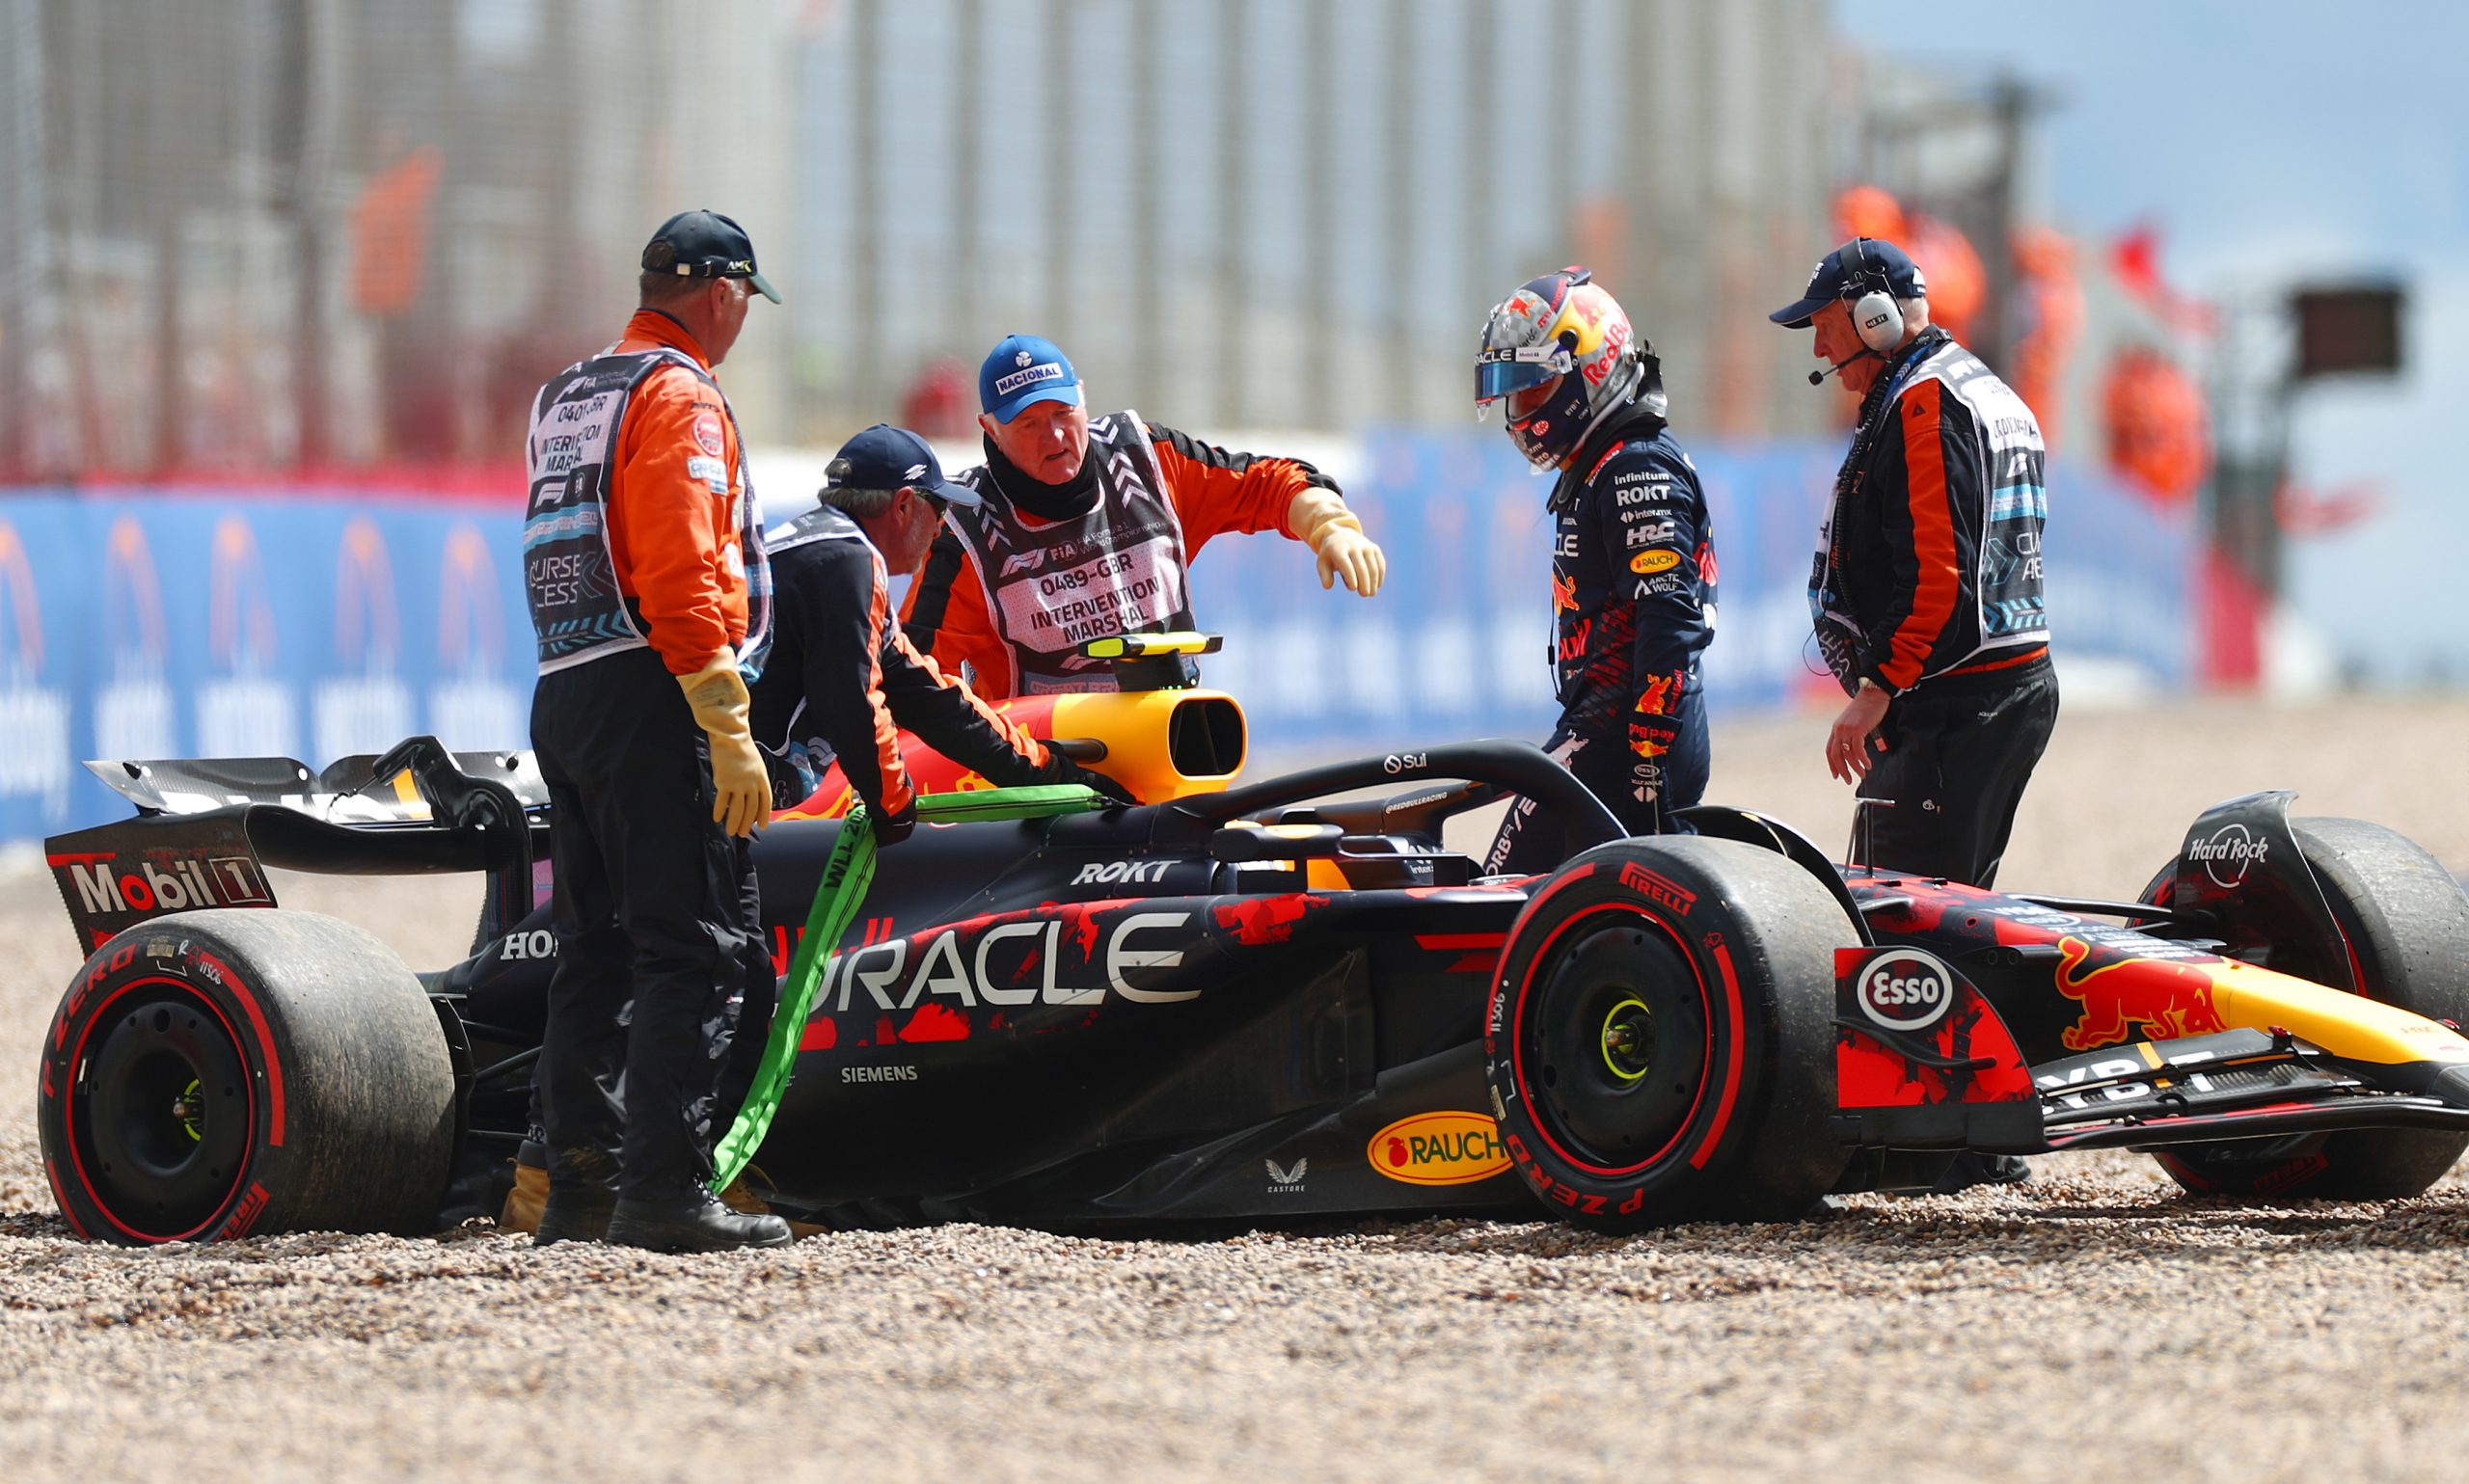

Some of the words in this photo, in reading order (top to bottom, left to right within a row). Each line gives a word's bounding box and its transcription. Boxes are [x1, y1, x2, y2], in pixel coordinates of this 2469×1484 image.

[1583, 335, 1618, 386] Red
[997, 366, 1058, 391] NACIONAL
[1614, 472, 1669, 485] infinitum
[1615, 485, 1670, 507] ROKT
[1626, 522, 1675, 546] HRC
[1642, 555, 1673, 567] RAUCH
[1040, 553, 1134, 597] 0489-GBR
[1648, 573, 1679, 586] ARCTIC
[1652, 582, 1678, 593] WOLF
[1030, 577, 1160, 630] INTERVENTION
[1063, 605, 1150, 644] MARSHAL
[1403, 753, 1427, 769] Sui
[1385, 792, 1448, 815] @REDBULLRACING
[2188, 837, 2233, 861] Hard
[2230, 836, 2268, 864] Rock
[825, 840, 854, 889] WLL
[1070, 859, 1182, 885] ROKT
[69, 860, 218, 914] Mobil
[1618, 860, 1697, 918] PIRELLI
[501, 930, 558, 960] HO
[53, 943, 137, 1052] ZERO
[1873, 971, 1940, 1005] Esso
[841, 1066, 918, 1084] SIEMENS
[1409, 1131, 1506, 1165] RAUCH
[1506, 1133, 1609, 1215] ZERO
[1267, 1184, 1306, 1193] CASTORE
[1618, 1188, 1644, 1215] P
